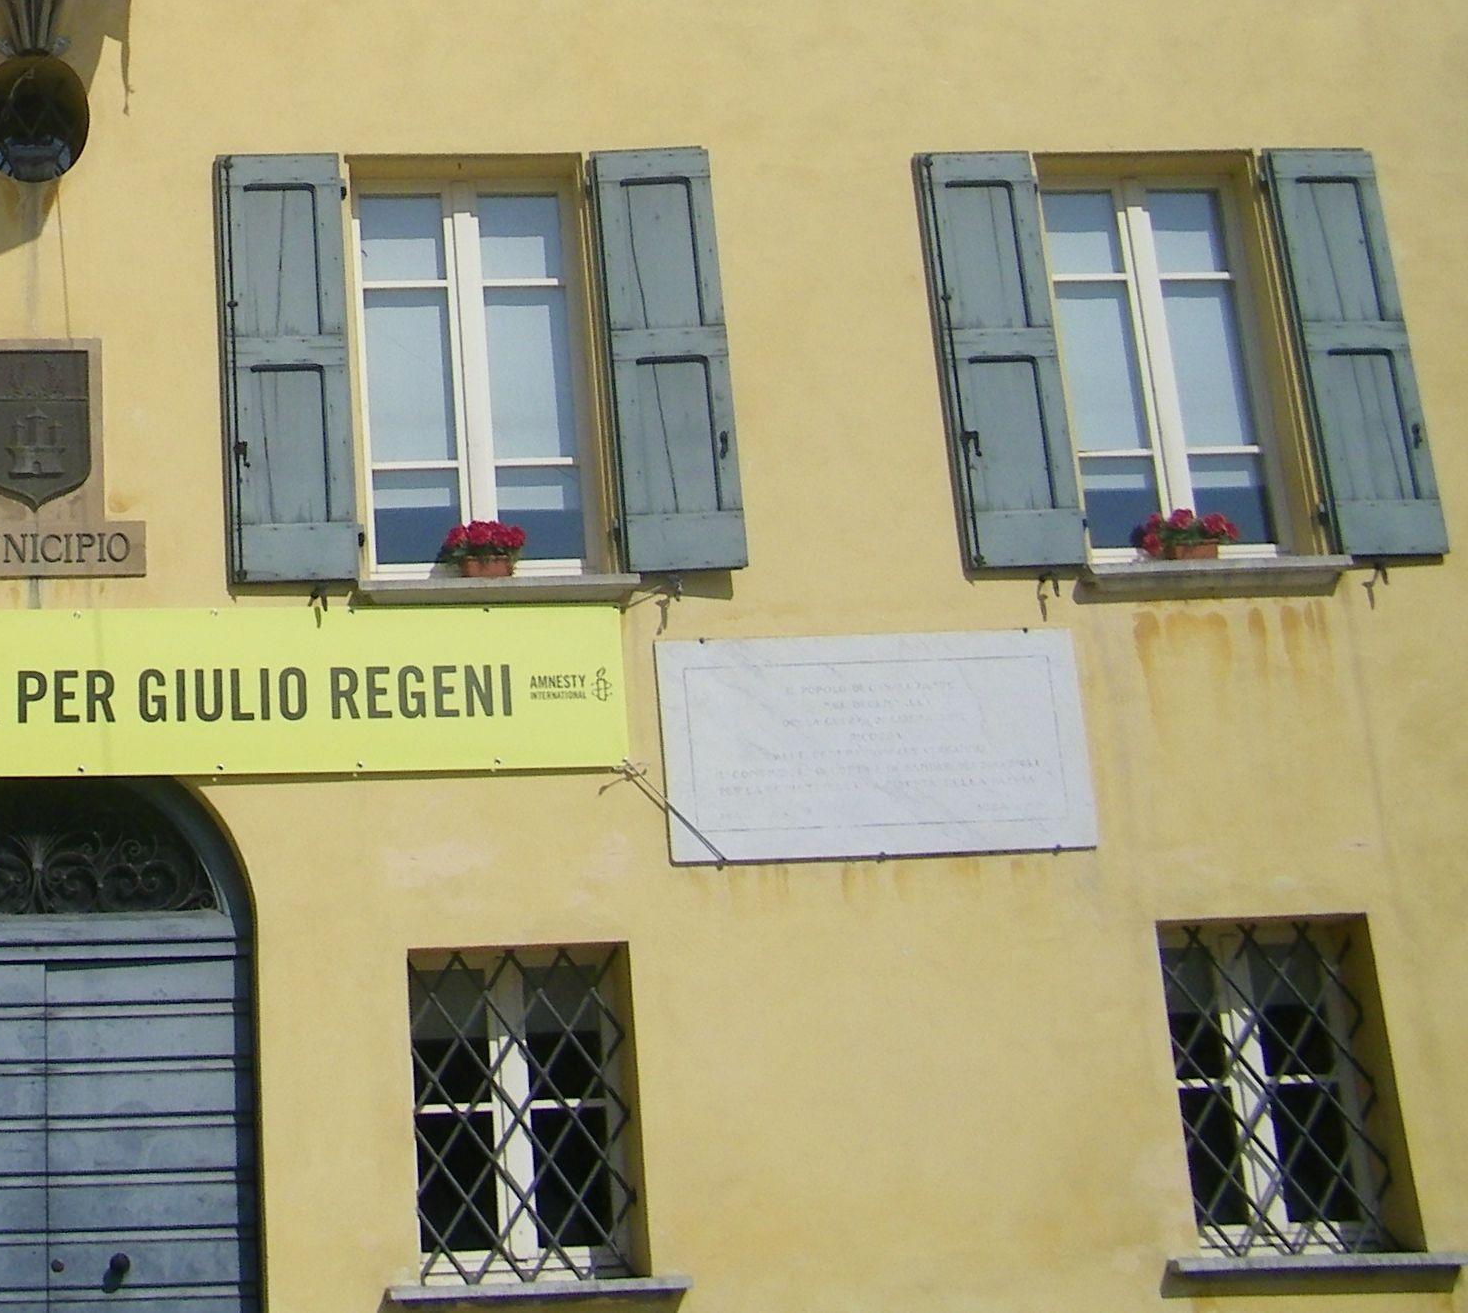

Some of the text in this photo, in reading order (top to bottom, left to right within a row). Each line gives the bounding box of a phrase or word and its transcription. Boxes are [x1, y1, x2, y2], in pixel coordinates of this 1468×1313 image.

[530, 674, 586, 688] AMNESTY
[17, 669, 116, 723] PER
[138, 666, 308, 722] GIULIO
[329, 663, 513, 720] REGENI
[530, 690, 586, 700] INTERNATIONAL
